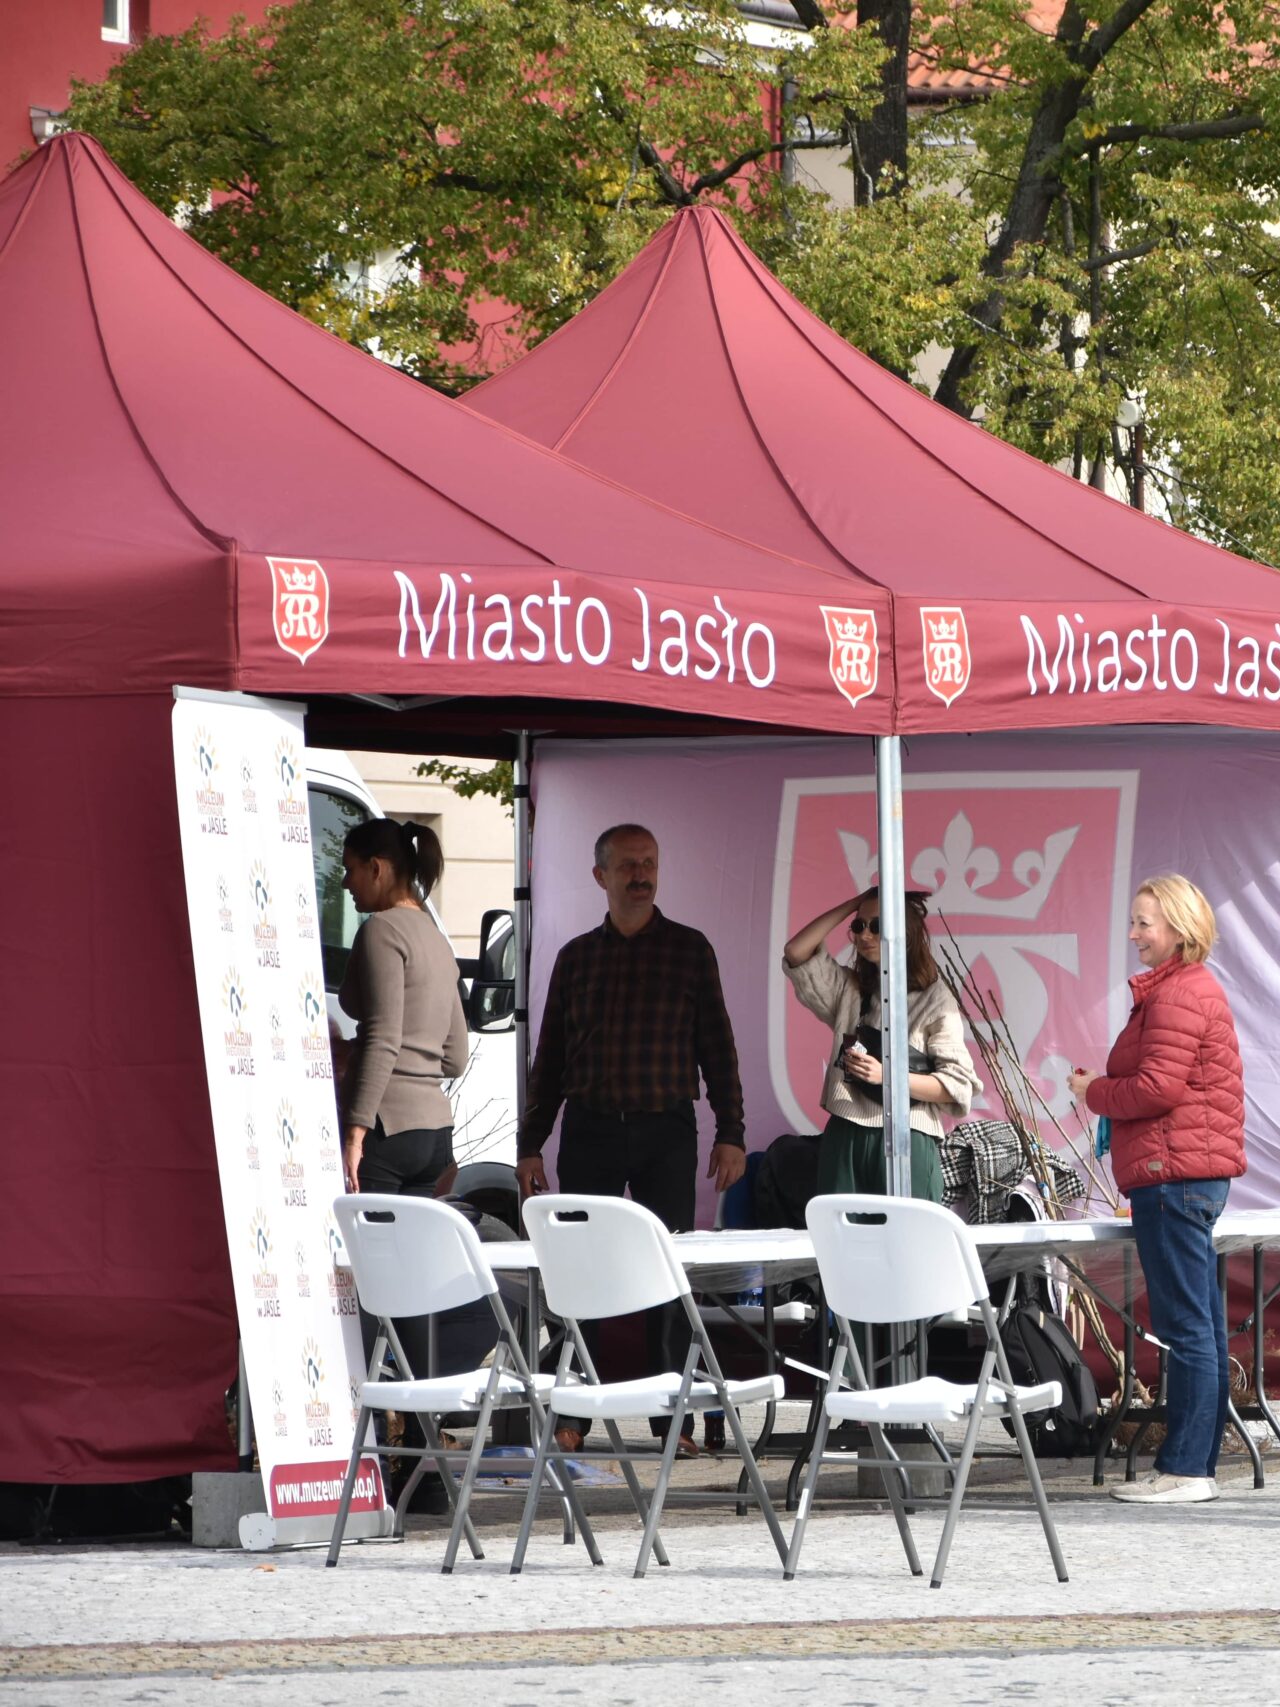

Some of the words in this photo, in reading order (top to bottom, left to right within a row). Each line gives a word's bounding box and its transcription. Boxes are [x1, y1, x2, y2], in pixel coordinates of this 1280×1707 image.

[393, 570, 611, 665] Miasto
[631, 587, 777, 689] Jasło
[1019, 613, 1199, 695] Miasto
